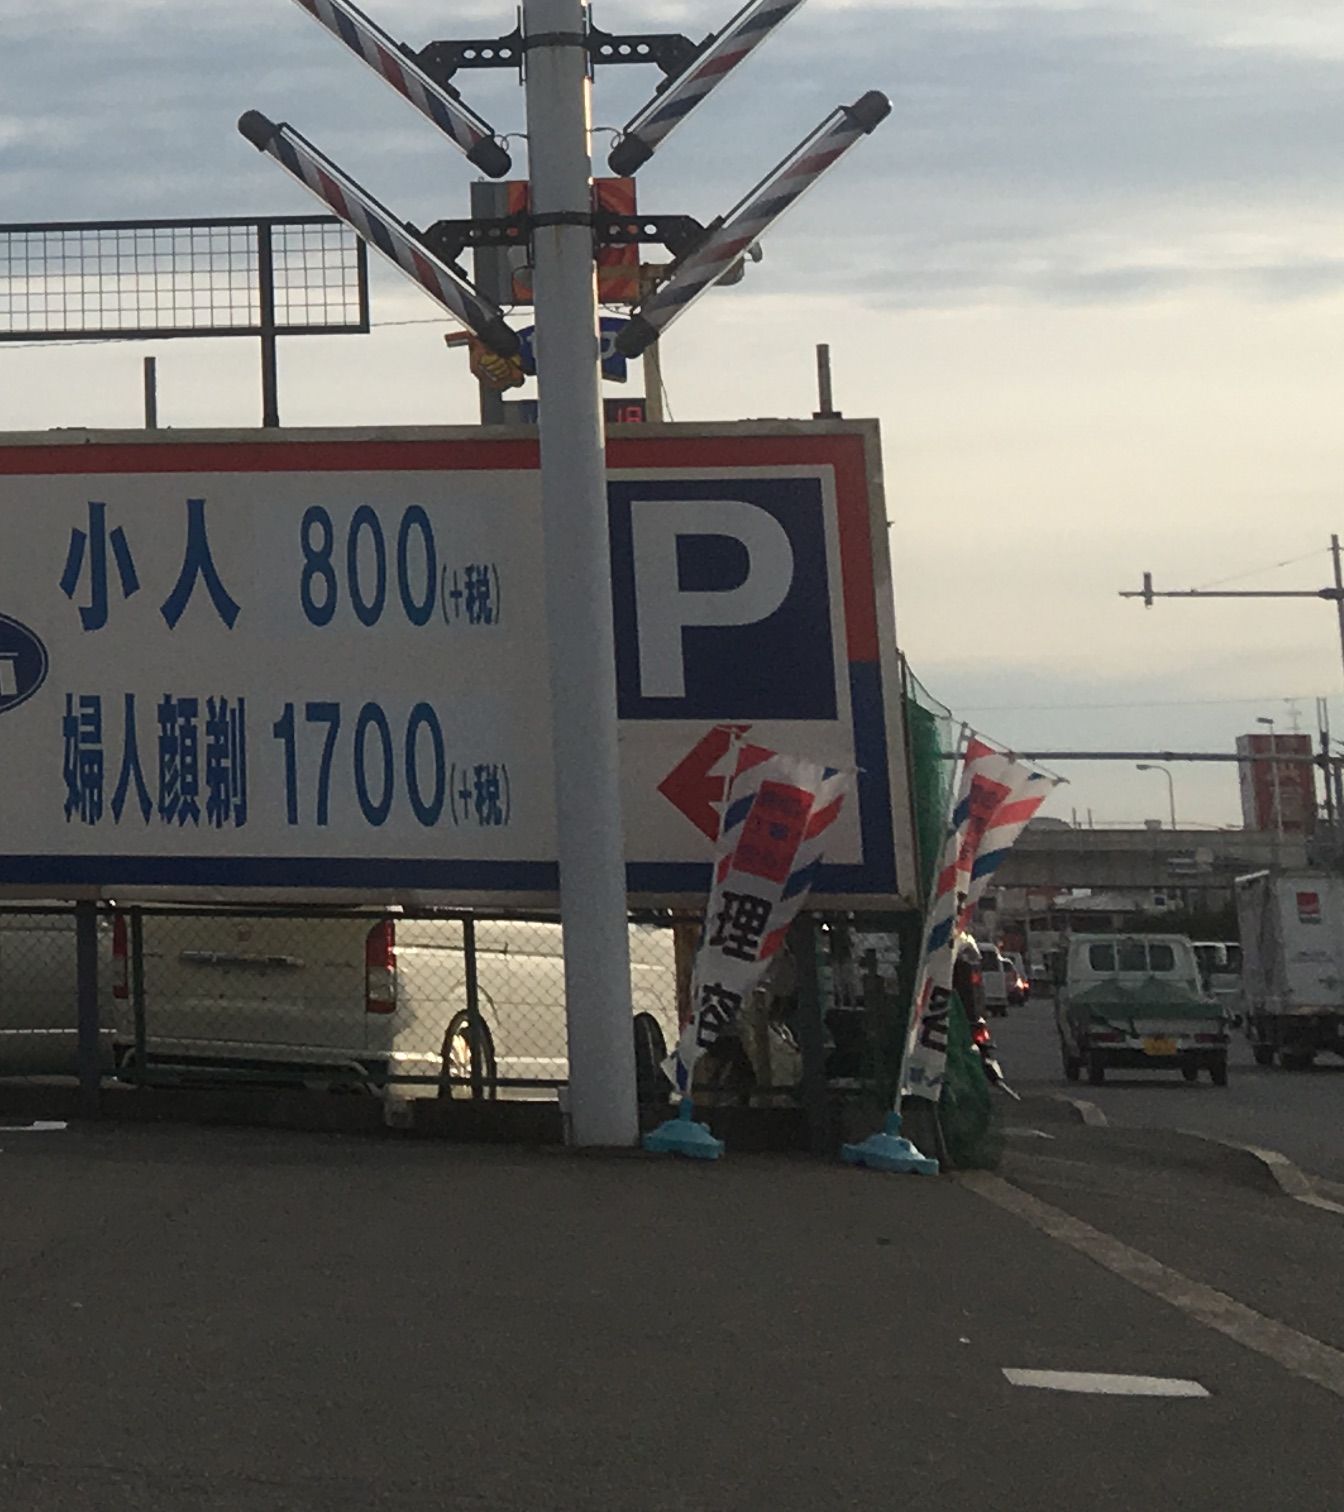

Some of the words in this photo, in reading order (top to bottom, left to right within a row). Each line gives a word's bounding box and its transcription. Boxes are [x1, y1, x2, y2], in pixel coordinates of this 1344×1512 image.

[59, 498, 242, 633] 小人
[300, 504, 438, 627] 800
[630, 499, 796, 699] P
[62, 692, 248, 831] 婦人顔剃
[273, 700, 447, 829] 1700
